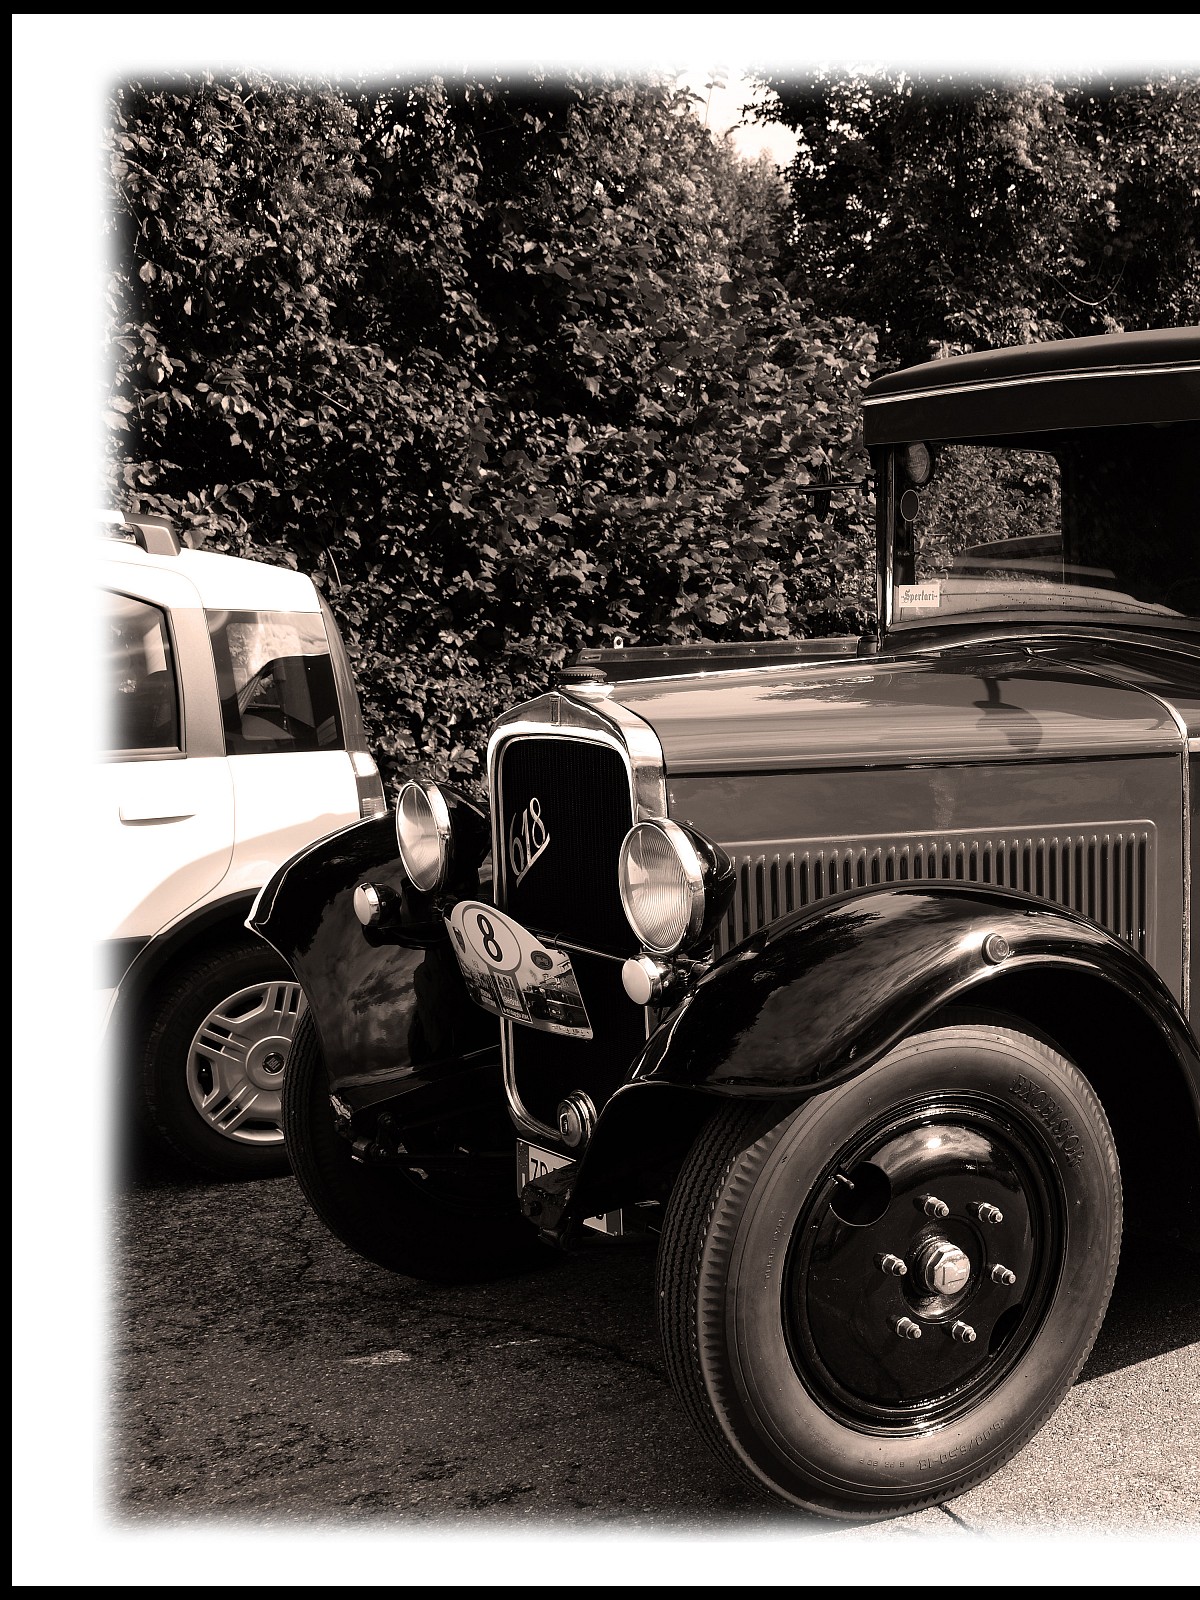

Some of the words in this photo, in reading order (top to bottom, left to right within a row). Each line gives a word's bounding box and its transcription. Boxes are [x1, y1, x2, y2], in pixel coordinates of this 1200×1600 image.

[509, 797, 548, 880] 618
[476, 913, 503, 963] 8
[495, 974, 515, 990] ASI
[1009, 1073, 1085, 1169] EXCELSIOR
